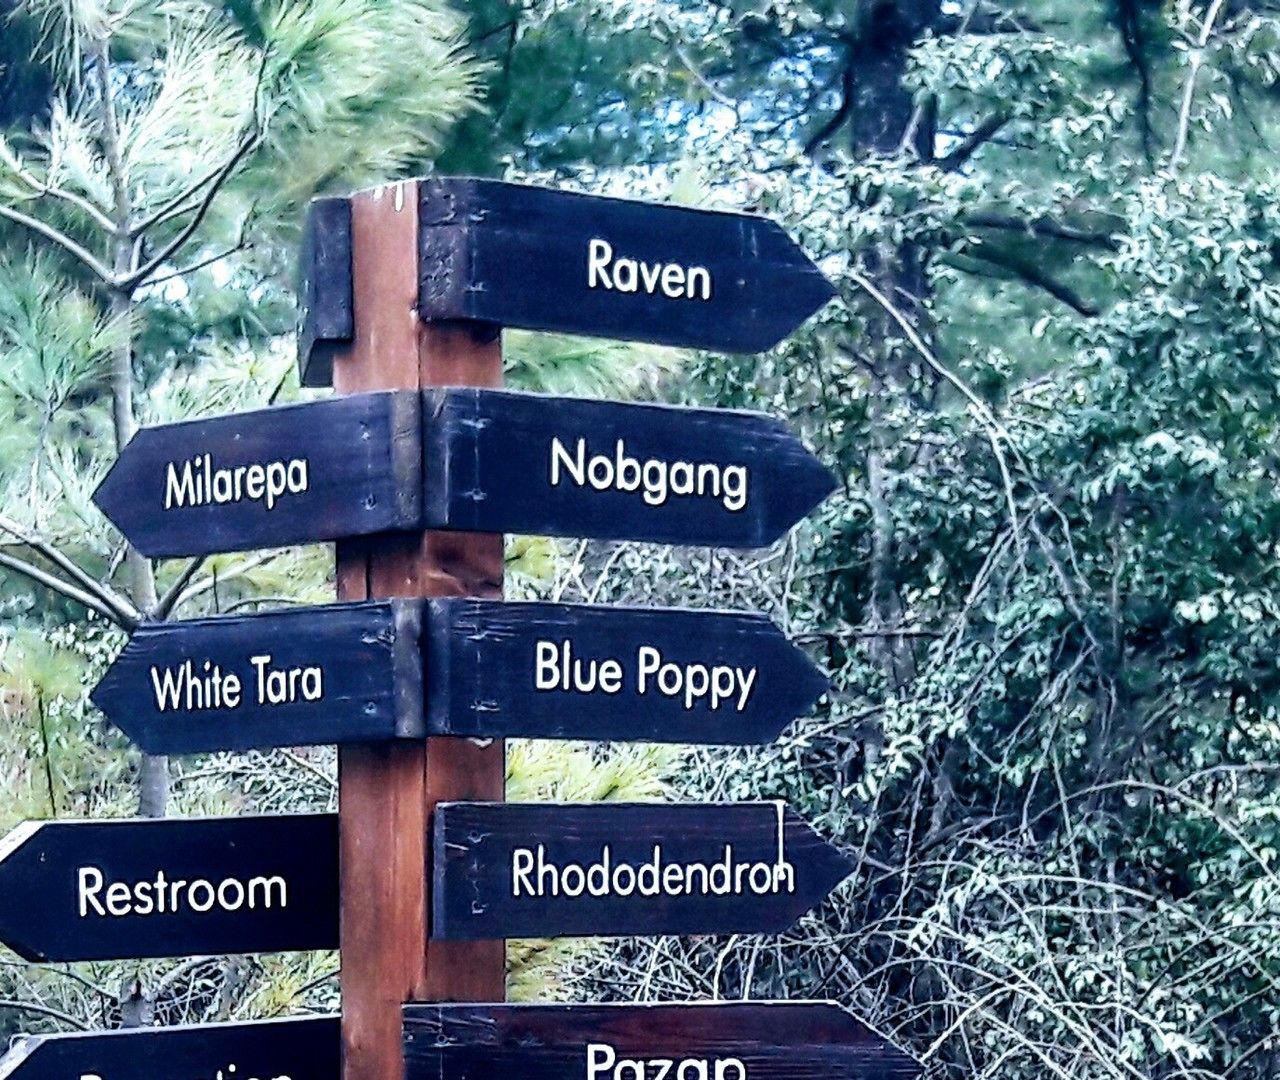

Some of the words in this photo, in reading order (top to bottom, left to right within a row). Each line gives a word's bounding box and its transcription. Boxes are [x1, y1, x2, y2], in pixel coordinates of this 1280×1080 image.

[588, 238, 711, 300] Raven
[165, 453, 308, 510] Milarepa
[551, 437, 747, 511] Nobgang
[150, 660, 241, 711] White
[250, 654, 322, 704] Tara
[536, 639, 623, 693] Blue
[638, 646, 757, 711] Poppy
[78, 866, 287, 917] Restroom
[512, 844, 795, 897] Rhododendron
